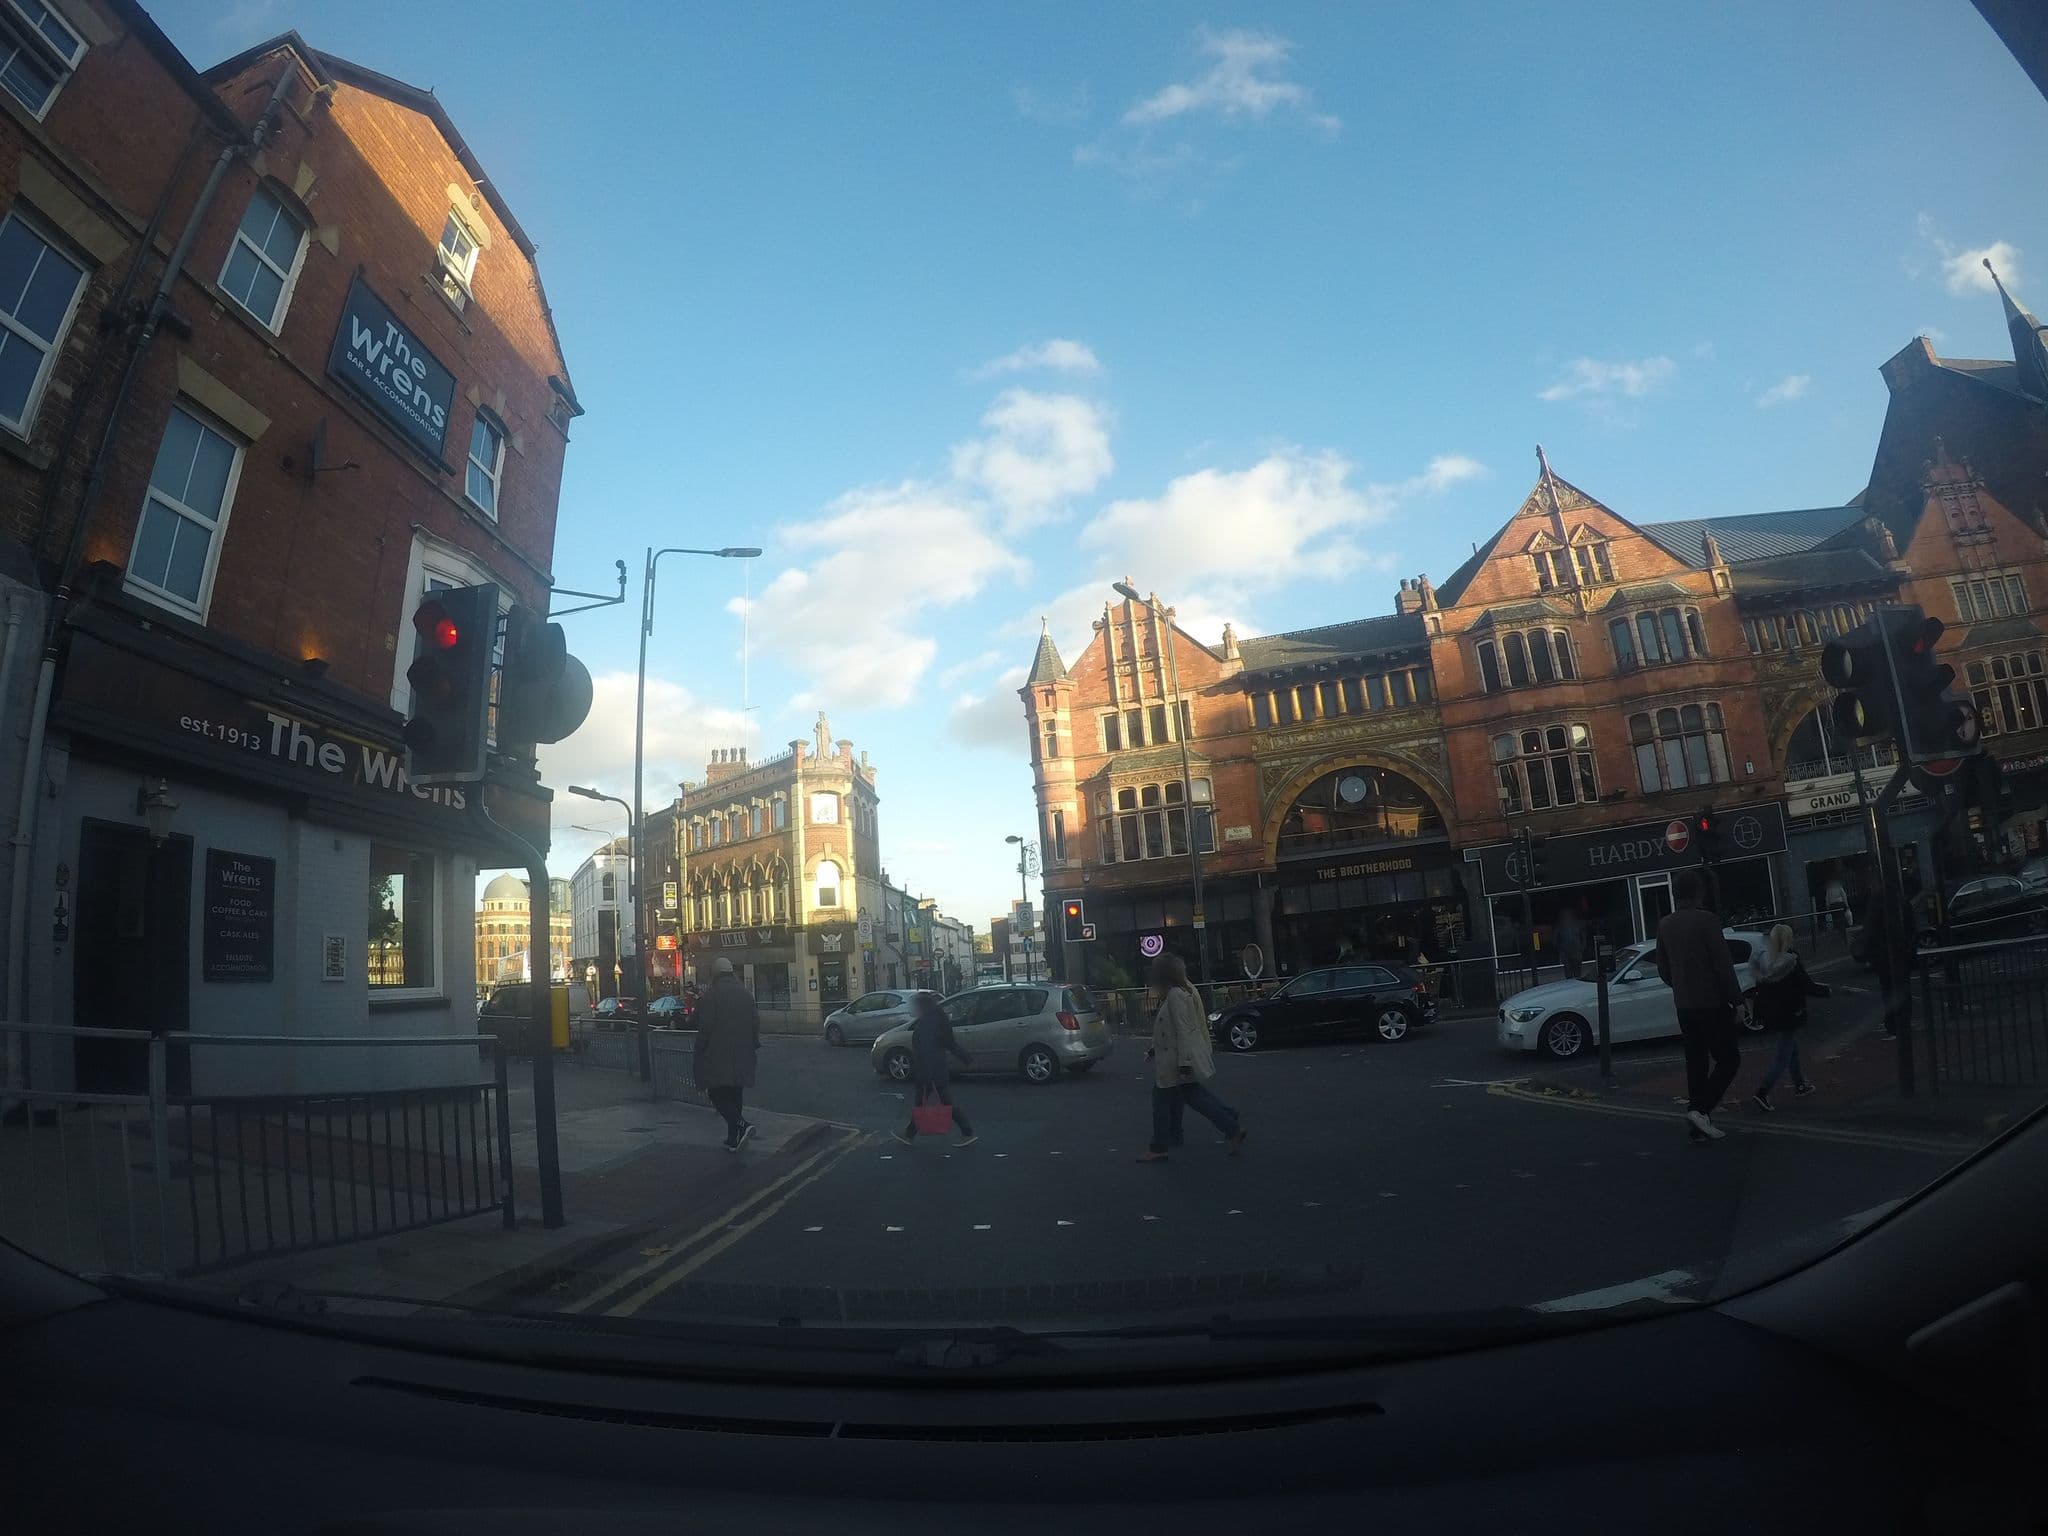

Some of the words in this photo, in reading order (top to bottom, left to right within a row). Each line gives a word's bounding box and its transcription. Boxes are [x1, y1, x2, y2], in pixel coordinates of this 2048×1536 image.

[385, 320, 427, 380] The
[351, 313, 446, 428] Wrens
[345, 350, 365, 371] BAR
[364, 368, 373, 379] &
[373, 376, 442, 441] ACCOMMODATION
[180, 713, 262, 750] est.1913
[266, 712, 346, 773] The
[1810, 792, 1851, 809] GRAND
[233, 861, 251, 873] The
[1317, 868, 1337, 879] THE
[1339, 858, 1413, 877] BROTHERHOOD
[222, 870, 262, 887] Wrens
[230, 898, 252, 908] FOOD
